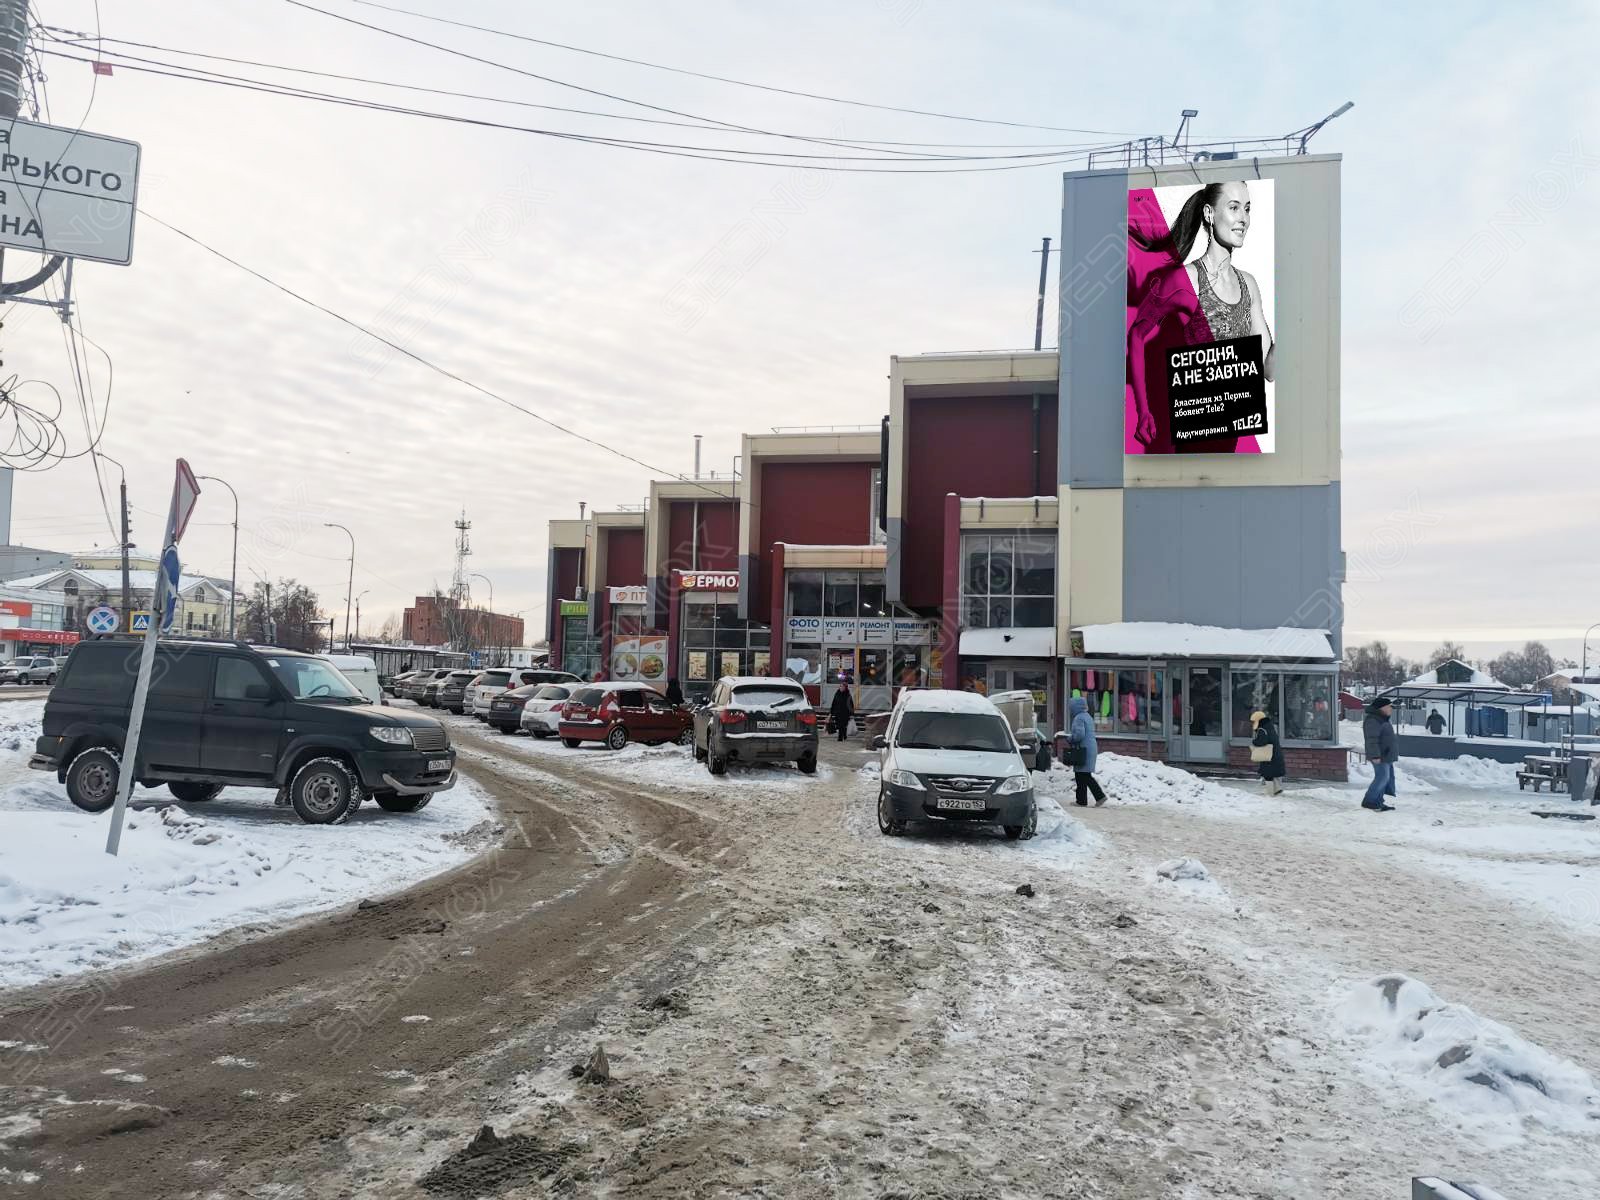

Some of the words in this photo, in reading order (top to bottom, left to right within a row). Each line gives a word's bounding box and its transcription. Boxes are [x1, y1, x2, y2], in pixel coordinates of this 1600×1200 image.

[1, 153, 122, 192] РЬКОГО
[0, 214, 43, 239] НА
[1171, 345, 1238, 368] СЕГОДНЯ,
[1171, 371, 1182, 387] А
[1184, 368, 1203, 385] НЕ
[1205, 360, 1259, 382] ЗАВТРА
[1173, 395, 1212, 408] Анастасия
[1174, 407, 1205, 418] абонент
[1205, 403, 1225, 413] Tele2
[1232, 412, 1263, 431] TELE2
[697, 575, 739, 588] ЕРМО
[789, 618, 820, 628] ФОТО
[825, 620, 855, 628] УСЛУГИ
